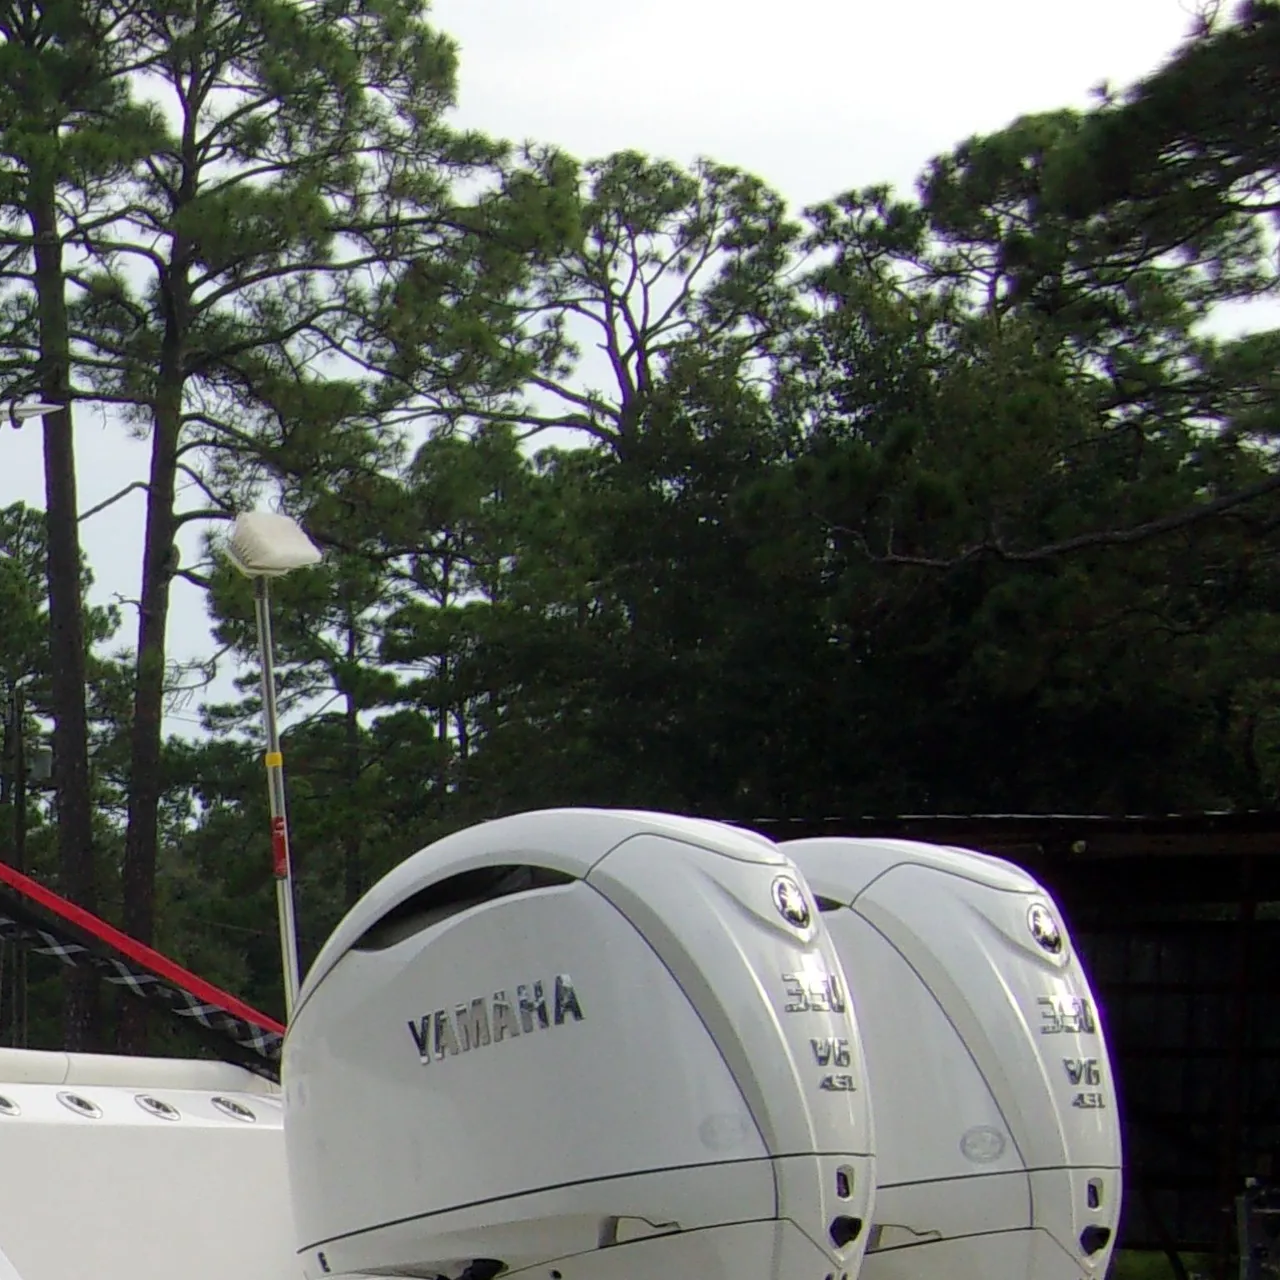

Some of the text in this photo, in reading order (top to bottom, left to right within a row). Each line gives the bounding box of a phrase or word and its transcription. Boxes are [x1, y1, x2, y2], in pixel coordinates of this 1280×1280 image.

[407, 973, 585, 1066] YAMAHA
[810, 1039, 851, 1068] V6
[1062, 1058, 1100, 1085] V6
